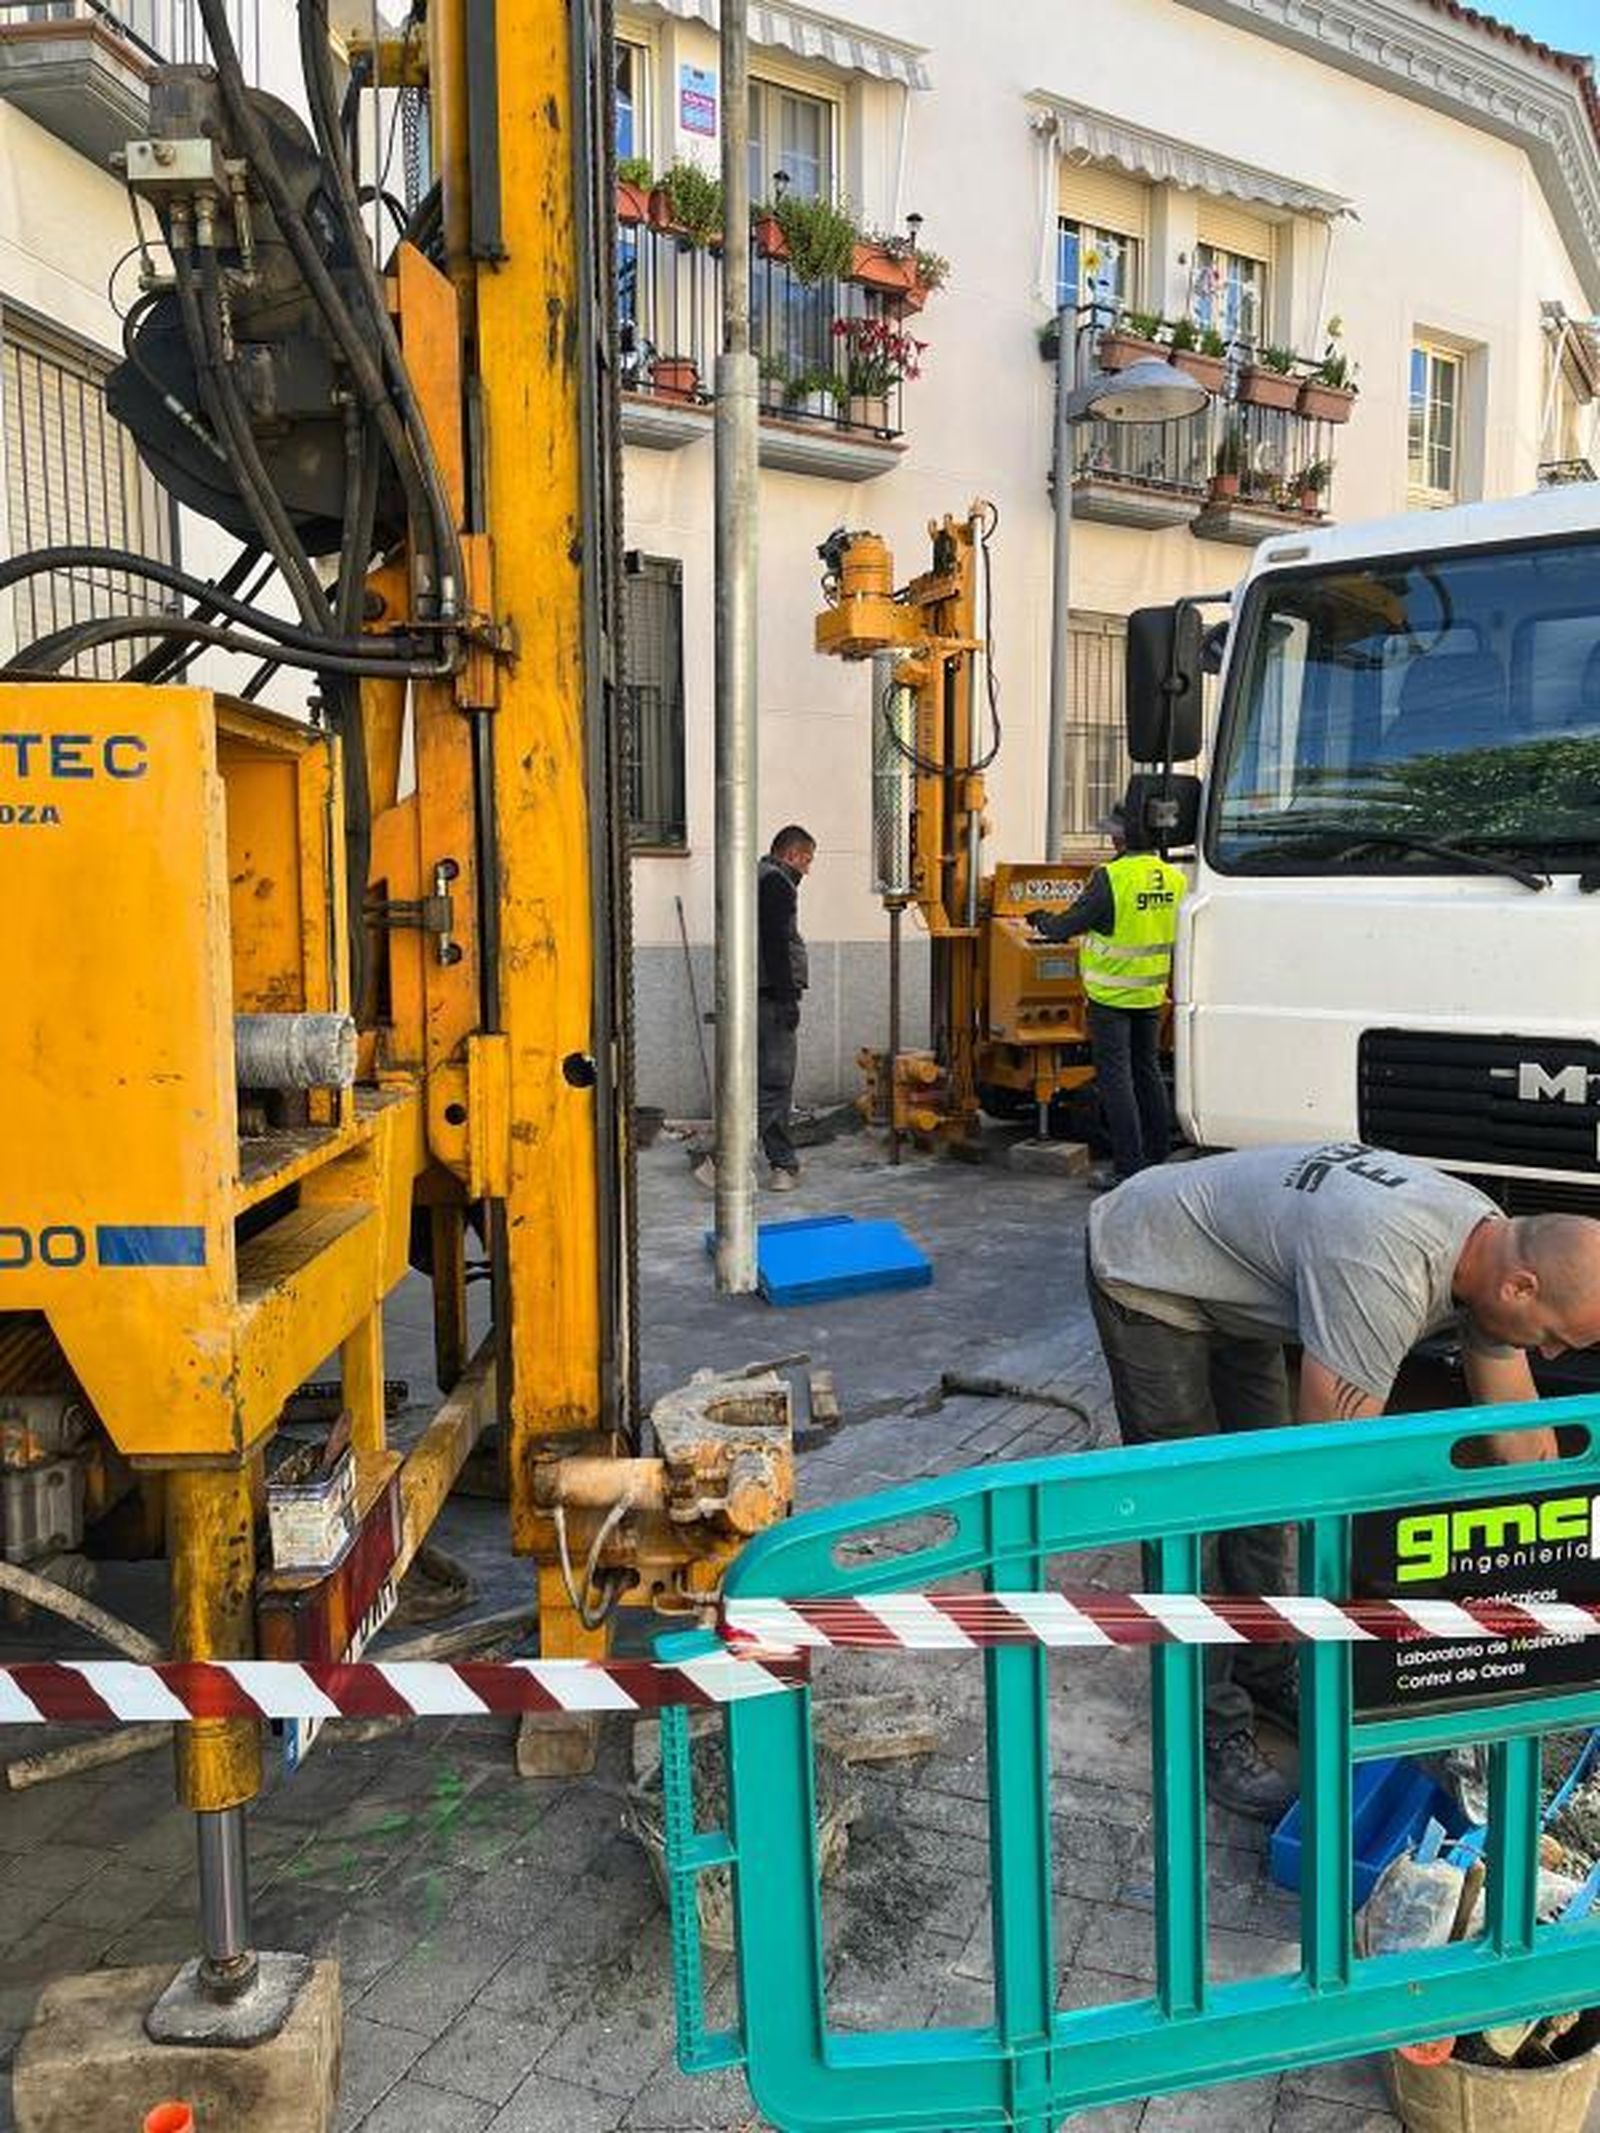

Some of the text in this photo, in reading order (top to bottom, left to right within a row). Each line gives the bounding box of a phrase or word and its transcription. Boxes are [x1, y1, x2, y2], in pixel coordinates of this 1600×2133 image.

[1, 734, 148, 779] TEC
[1137, 892, 1174, 911] gmc
[1518, 1062, 1600, 1105] M
[1396, 1496, 1589, 1583] gmc
[1396, 1644, 1484, 1667] Laboratorio
[1487, 1640, 1509, 1655] de
[1396, 1662, 1527, 1689] Control de Obras
